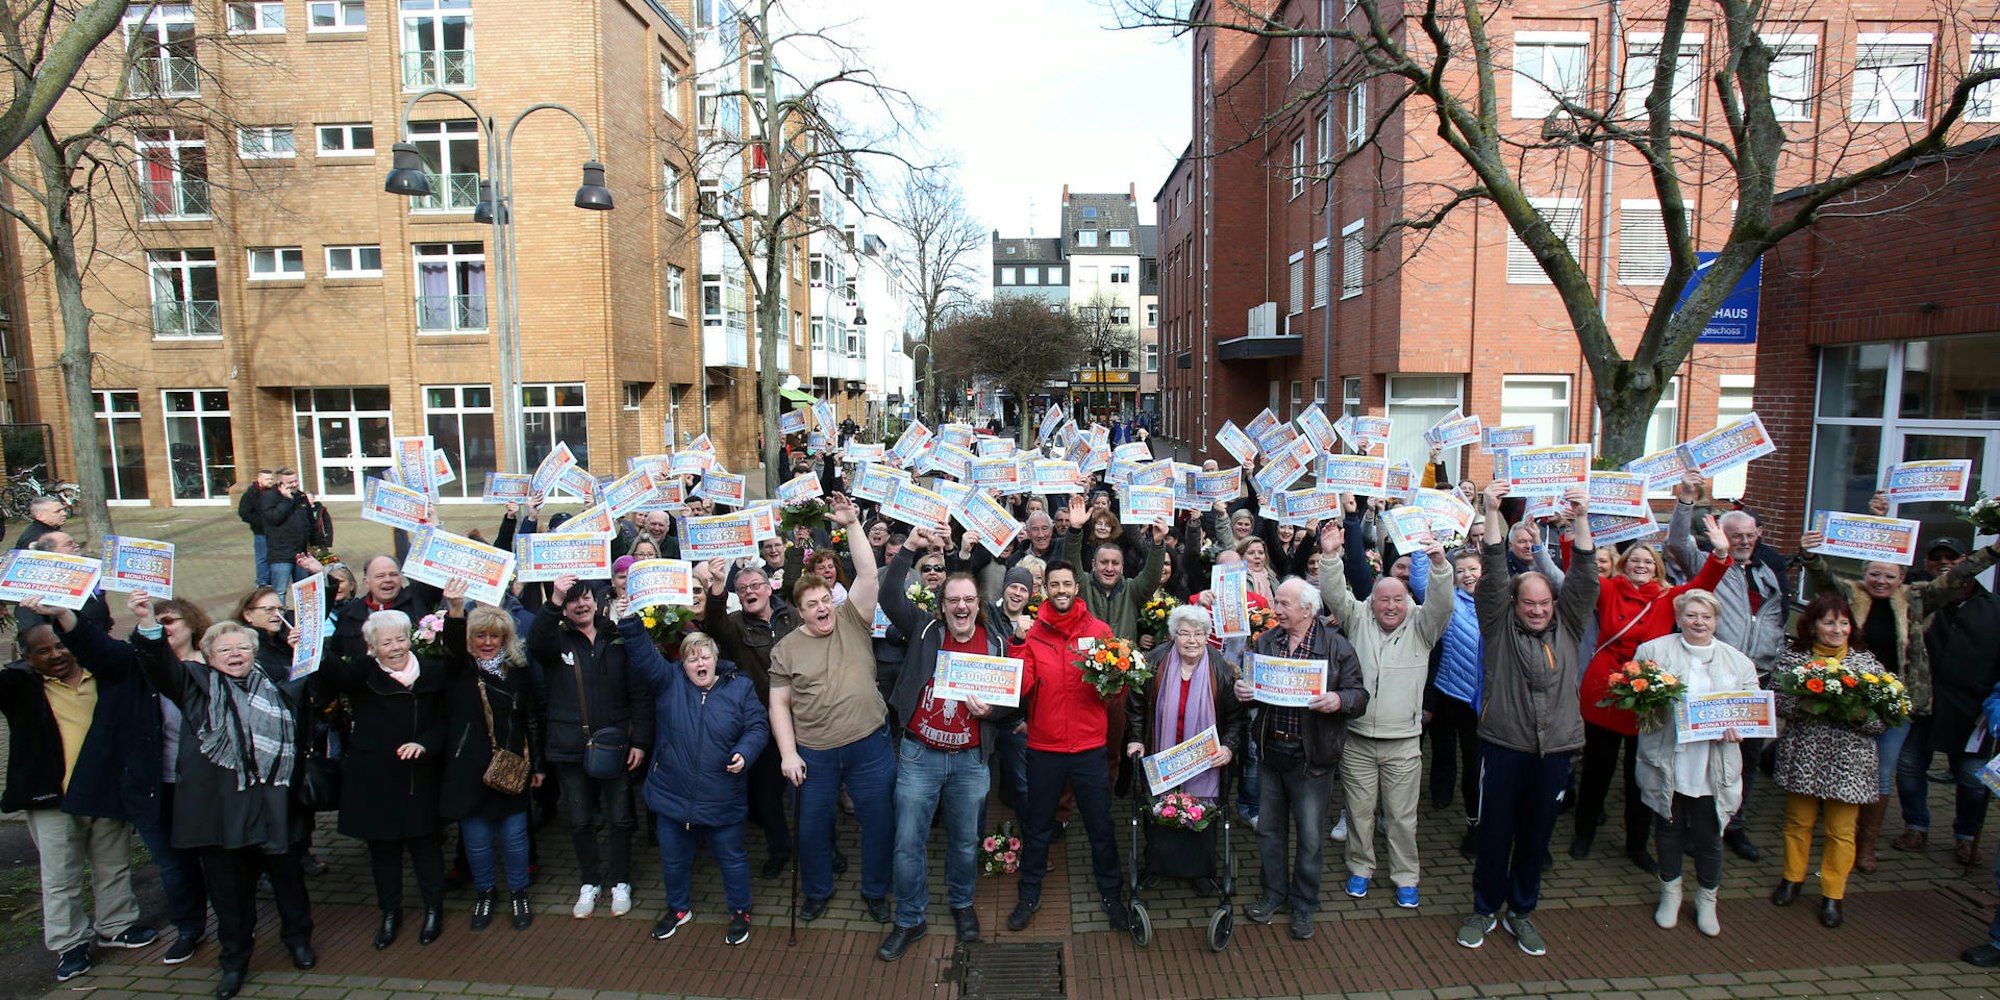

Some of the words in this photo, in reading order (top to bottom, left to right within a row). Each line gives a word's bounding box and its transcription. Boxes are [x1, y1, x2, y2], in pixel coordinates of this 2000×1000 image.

[1691, 435, 1723, 452] POSTCODE
[1705, 441, 1757, 466] MONATSGEWINN
[1519, 476, 1577, 484] MONATSGEWINN
[121, 546, 149, 555] POSTCODE
[433, 537, 469, 554] POSTCODE
[697, 541, 744, 549] MONATSGEWINN
[1833, 539, 1897, 552] MONATSGEWINN
[16, 557, 57, 567] POSTCODE
[124, 572, 166, 585] MONATSGEWINN
[430, 562, 489, 584] MONATSGEWINN
[8, 581, 72, 595] MONATSGEWINN
[951, 661, 982, 669] POSTCODE
[955, 682, 1006, 693] MONATSGEWINN
[1698, 720, 1758, 729] MONATSGEWINN
[936, 732, 965, 743] DIABLO
